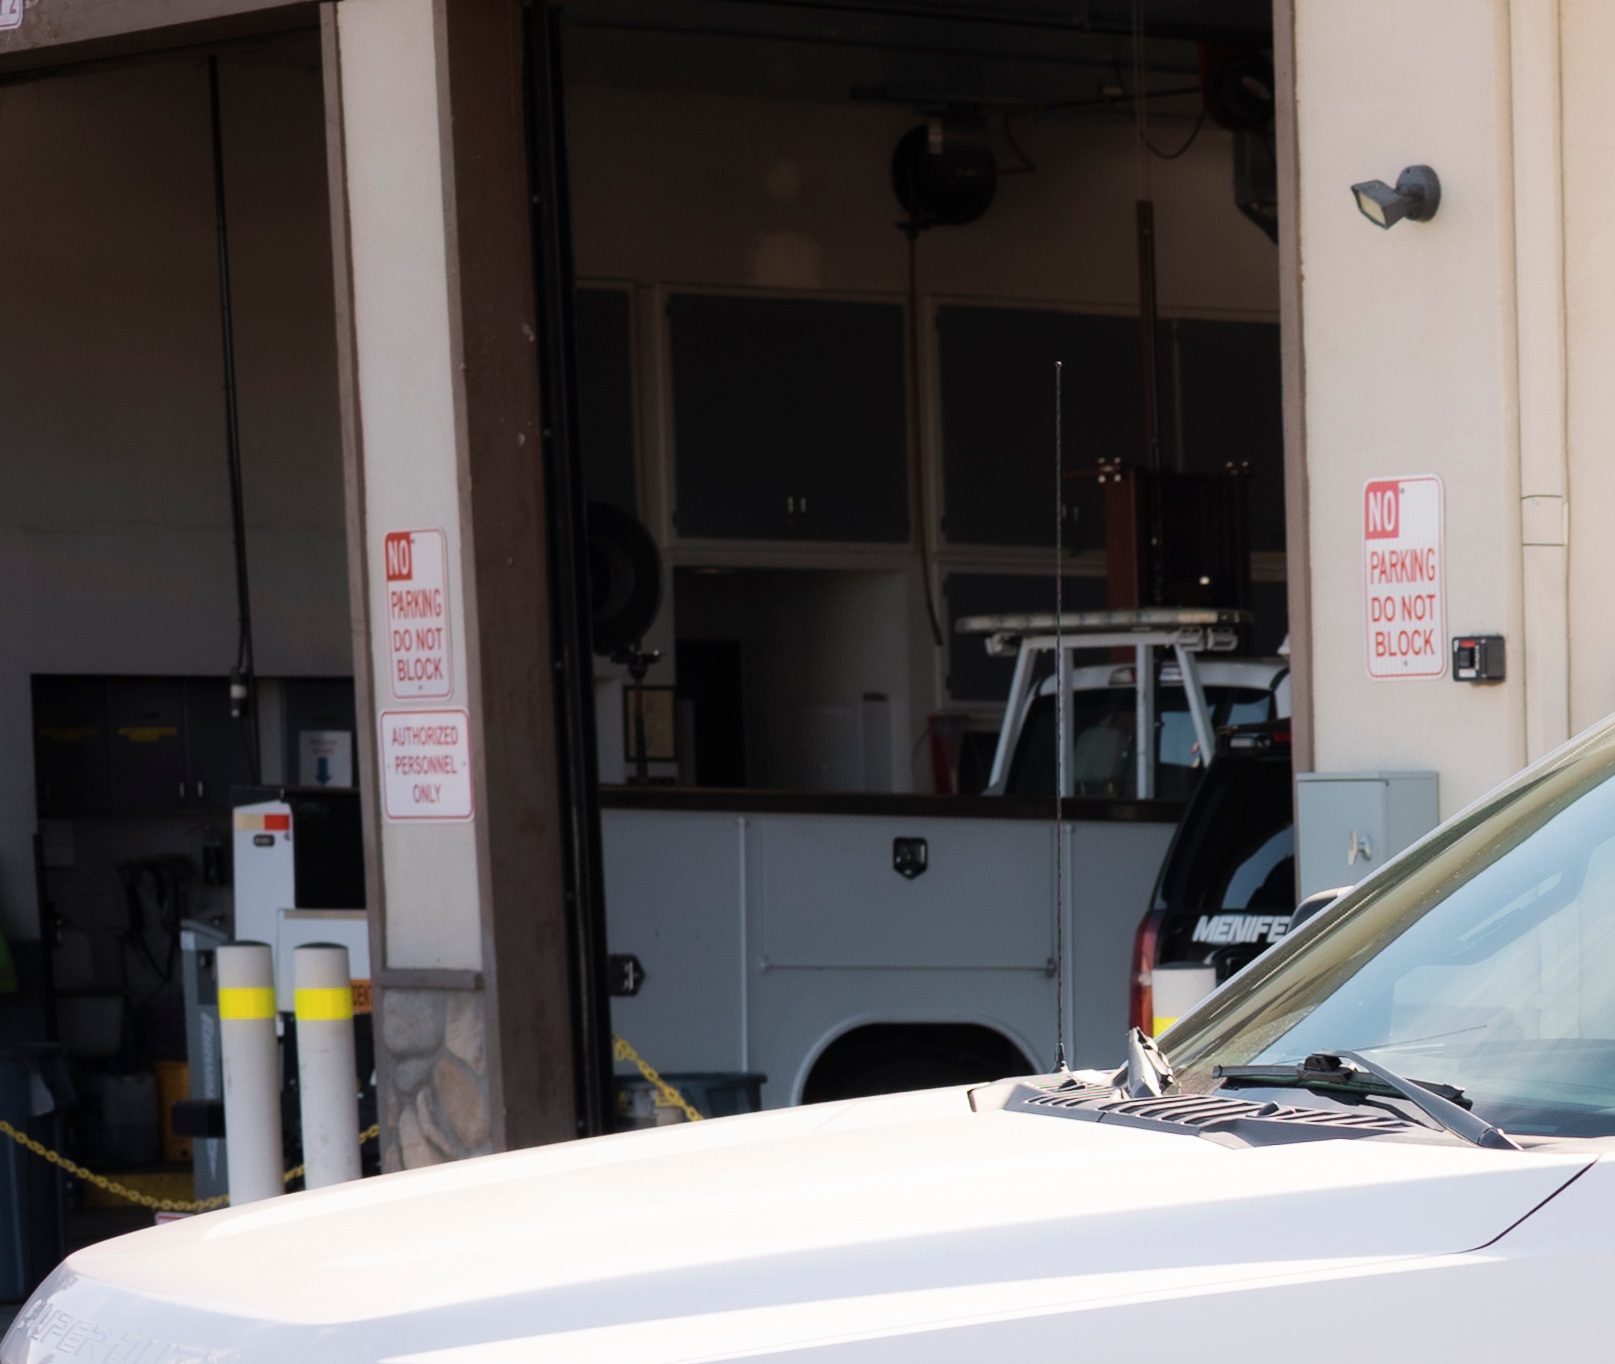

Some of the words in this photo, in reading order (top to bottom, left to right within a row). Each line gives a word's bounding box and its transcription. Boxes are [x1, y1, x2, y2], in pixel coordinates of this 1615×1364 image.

[1368, 490, 1396, 532] NO
[387, 539, 410, 576] NO
[1370, 548, 1436, 584] PARKING
[391, 589, 442, 619] PARKING
[1371, 596, 1396, 622] DO
[1402, 594, 1436, 621] NOT
[393, 630, 413, 652] DO
[415, 628, 443, 651] NOT
[1375, 628, 1436, 658] BLOCK
[397, 658, 444, 681] BLOCK
[392, 726, 459, 746] AUTHORIZED
[395, 755, 458, 775] PERSONNEL
[413, 784, 442, 803] ONLY
[1191, 914, 1293, 943] MENIFE
